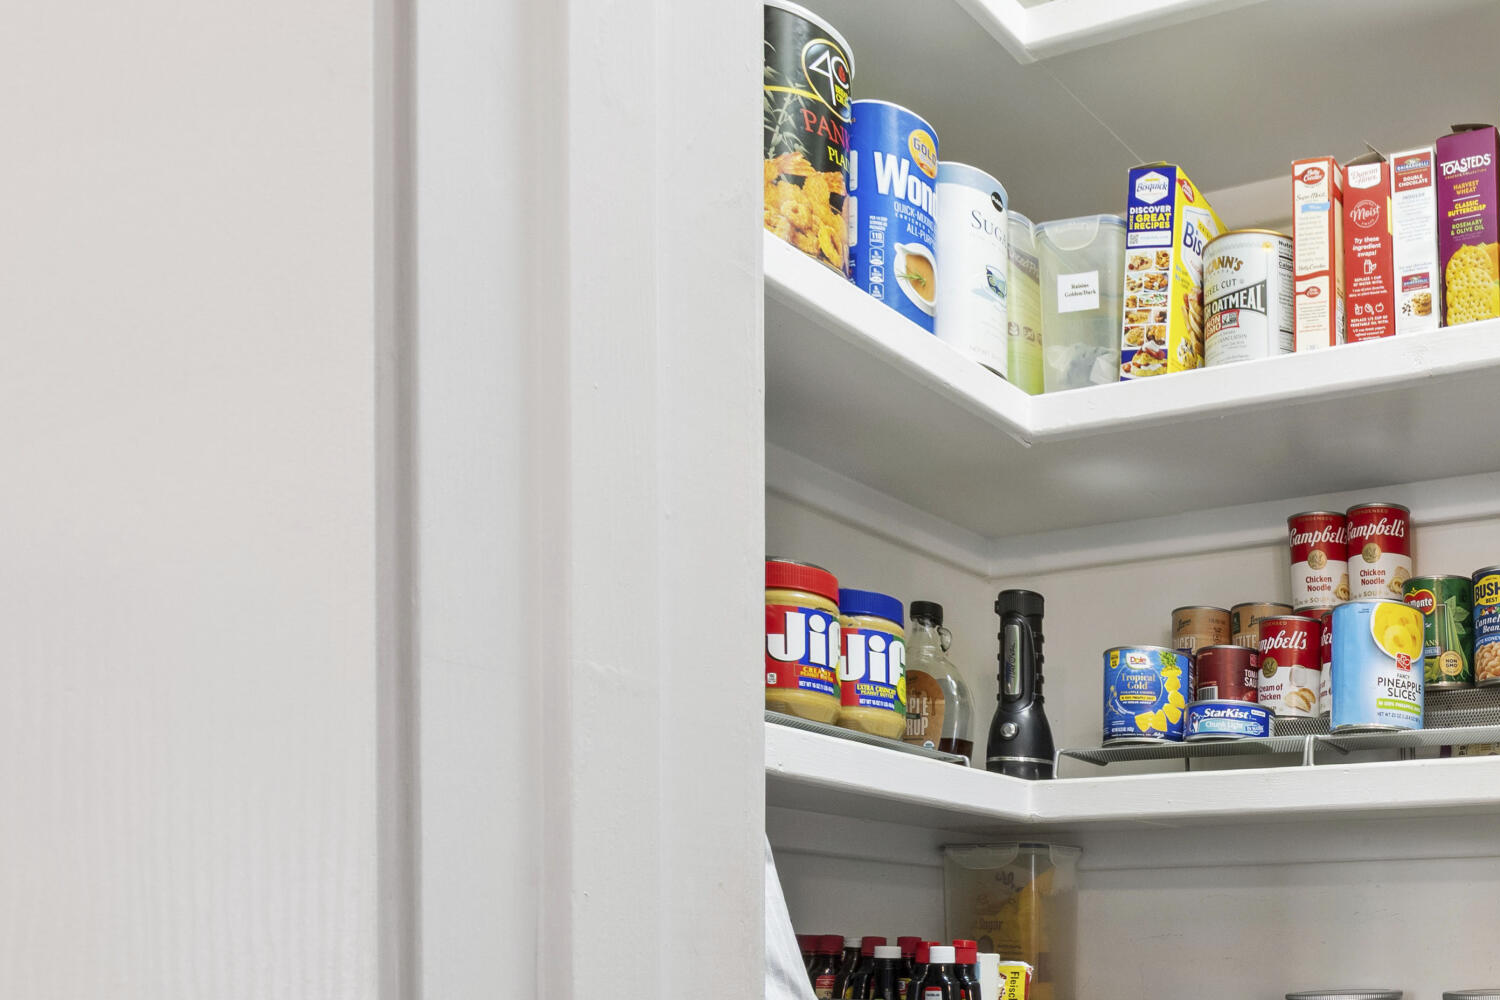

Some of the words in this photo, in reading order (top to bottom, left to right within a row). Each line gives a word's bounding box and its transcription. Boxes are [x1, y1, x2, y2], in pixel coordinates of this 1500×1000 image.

[1440, 153, 1491, 176] TOASTEDS
[1398, 178, 1428, 187] CHOCOLATE
[1402, 174, 1423, 182] DOUBLE
[1453, 180, 1479, 190] HARVEST
[1456, 187, 1476, 195] WHEAT
[1454, 199, 1479, 209] CLASSIC
[1129, 205, 1172, 214] DISCOVER
[1350, 205, 1381, 222] Moist
[1135, 212, 1172, 223] GREAT
[1134, 221, 1170, 230] RECIPES
[1452, 219, 1482, 229] ROSEMARY
[1456, 226, 1472, 235] OLIVE
[1354, 237, 1363, 245] Try
[1353, 243, 1382, 252] ingredient
[1211, 284, 1266, 314] OATMEAL
[1359, 568, 1386, 577] Chicken
[1305, 575, 1332, 584] Chicken
[1360, 577, 1385, 586] Noodle
[1307, 584, 1332, 592] Noodle
[840, 633, 906, 686] Jif
[1121, 672, 1155, 684] Tropical
[1127, 681, 1148, 690] Gold
[1377, 676, 1421, 694] PINEAPPLE
[1387, 687, 1416, 701] SLICES
[1204, 708, 1249, 719] StarKist
